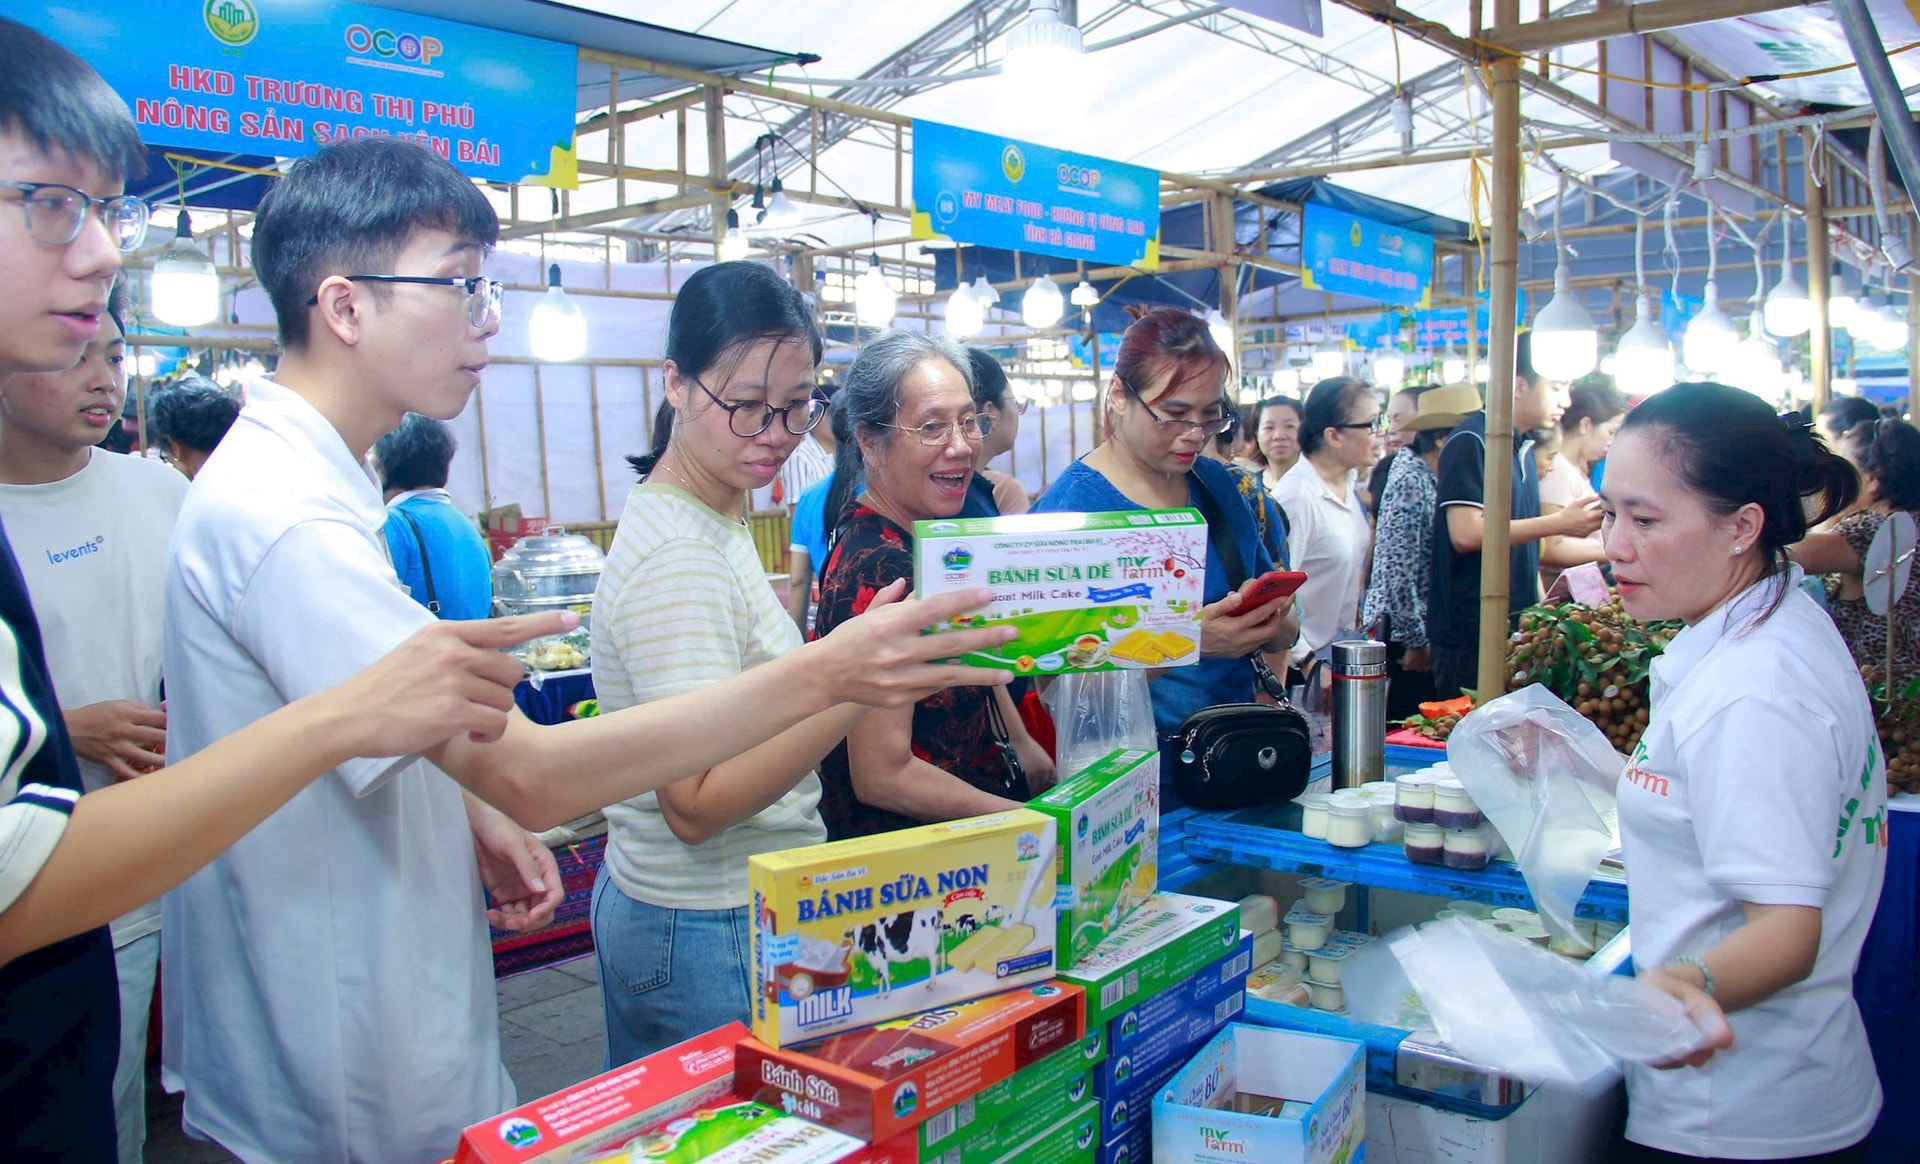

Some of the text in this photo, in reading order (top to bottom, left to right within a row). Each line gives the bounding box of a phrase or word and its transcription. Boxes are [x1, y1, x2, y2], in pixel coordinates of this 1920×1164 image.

[345, 24, 443, 65] OCOP
[169, 64, 475, 129] HKD TRƯƠNG THỊ PHÚ
[136, 97, 230, 134] NÔNG
[240, 107, 304, 143] SẢN
[458, 137, 500, 166] BÁI
[1057, 163, 1099, 189] OCOP
[962, 191, 982, 208] MY
[985, 193, 1014, 214] MEAT
[1016, 200, 1044, 219] FOOD
[1065, 230, 1096, 250] GIANG
[987, 565, 1041, 586] BÁNH
[1087, 560, 1112, 581] DÊ
[1122, 565, 1165, 580] farm
[1021, 590, 1046, 601] Milk
[1051, 588, 1082, 600] Cake
[846, 870, 857, 878] Ba
[797, 863, 989, 924] BÁNH SỮA NON
[797, 984, 853, 1027] MILK
[762, 1059, 804, 1095] Bánh
[805, 1074, 840, 1107] Sữa
[1200, 1126, 1245, 1155] my farm
